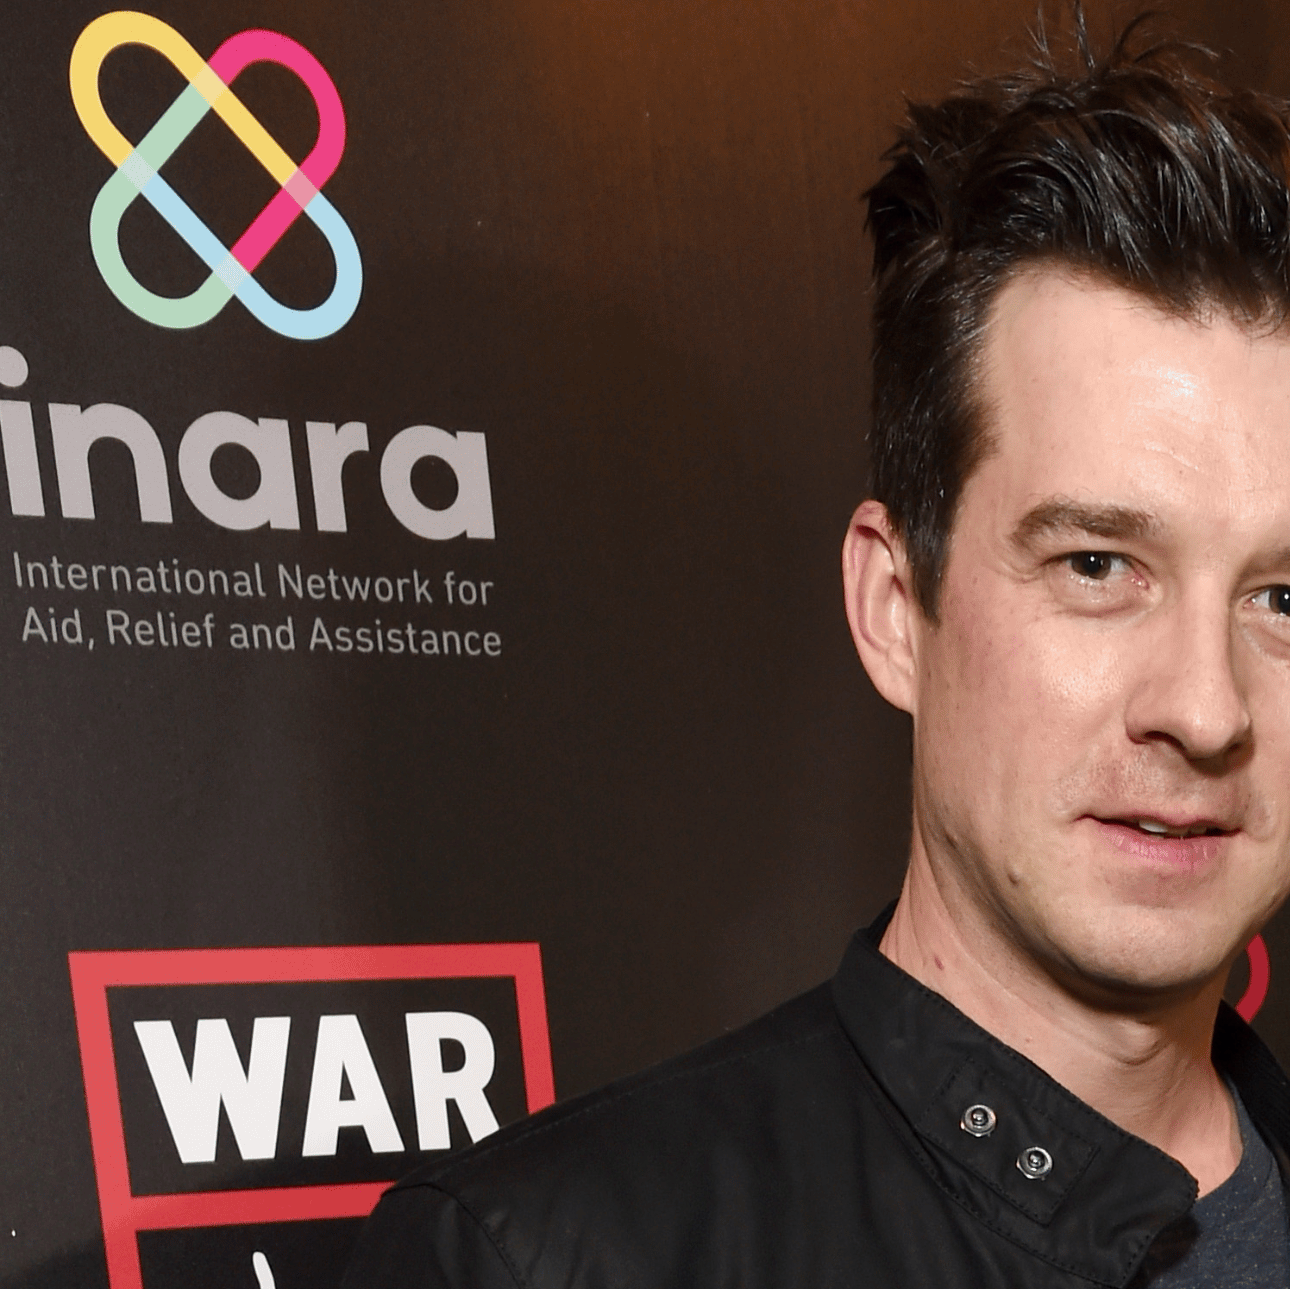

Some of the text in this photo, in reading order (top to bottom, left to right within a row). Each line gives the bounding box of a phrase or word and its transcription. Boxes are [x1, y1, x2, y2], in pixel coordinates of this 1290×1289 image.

[0, 346, 496, 541] inara
[13, 551, 495, 606] International Network for
[22, 606, 502, 656] Aid, Relief and Assistance
[133, 1011, 500, 1164] WAR
